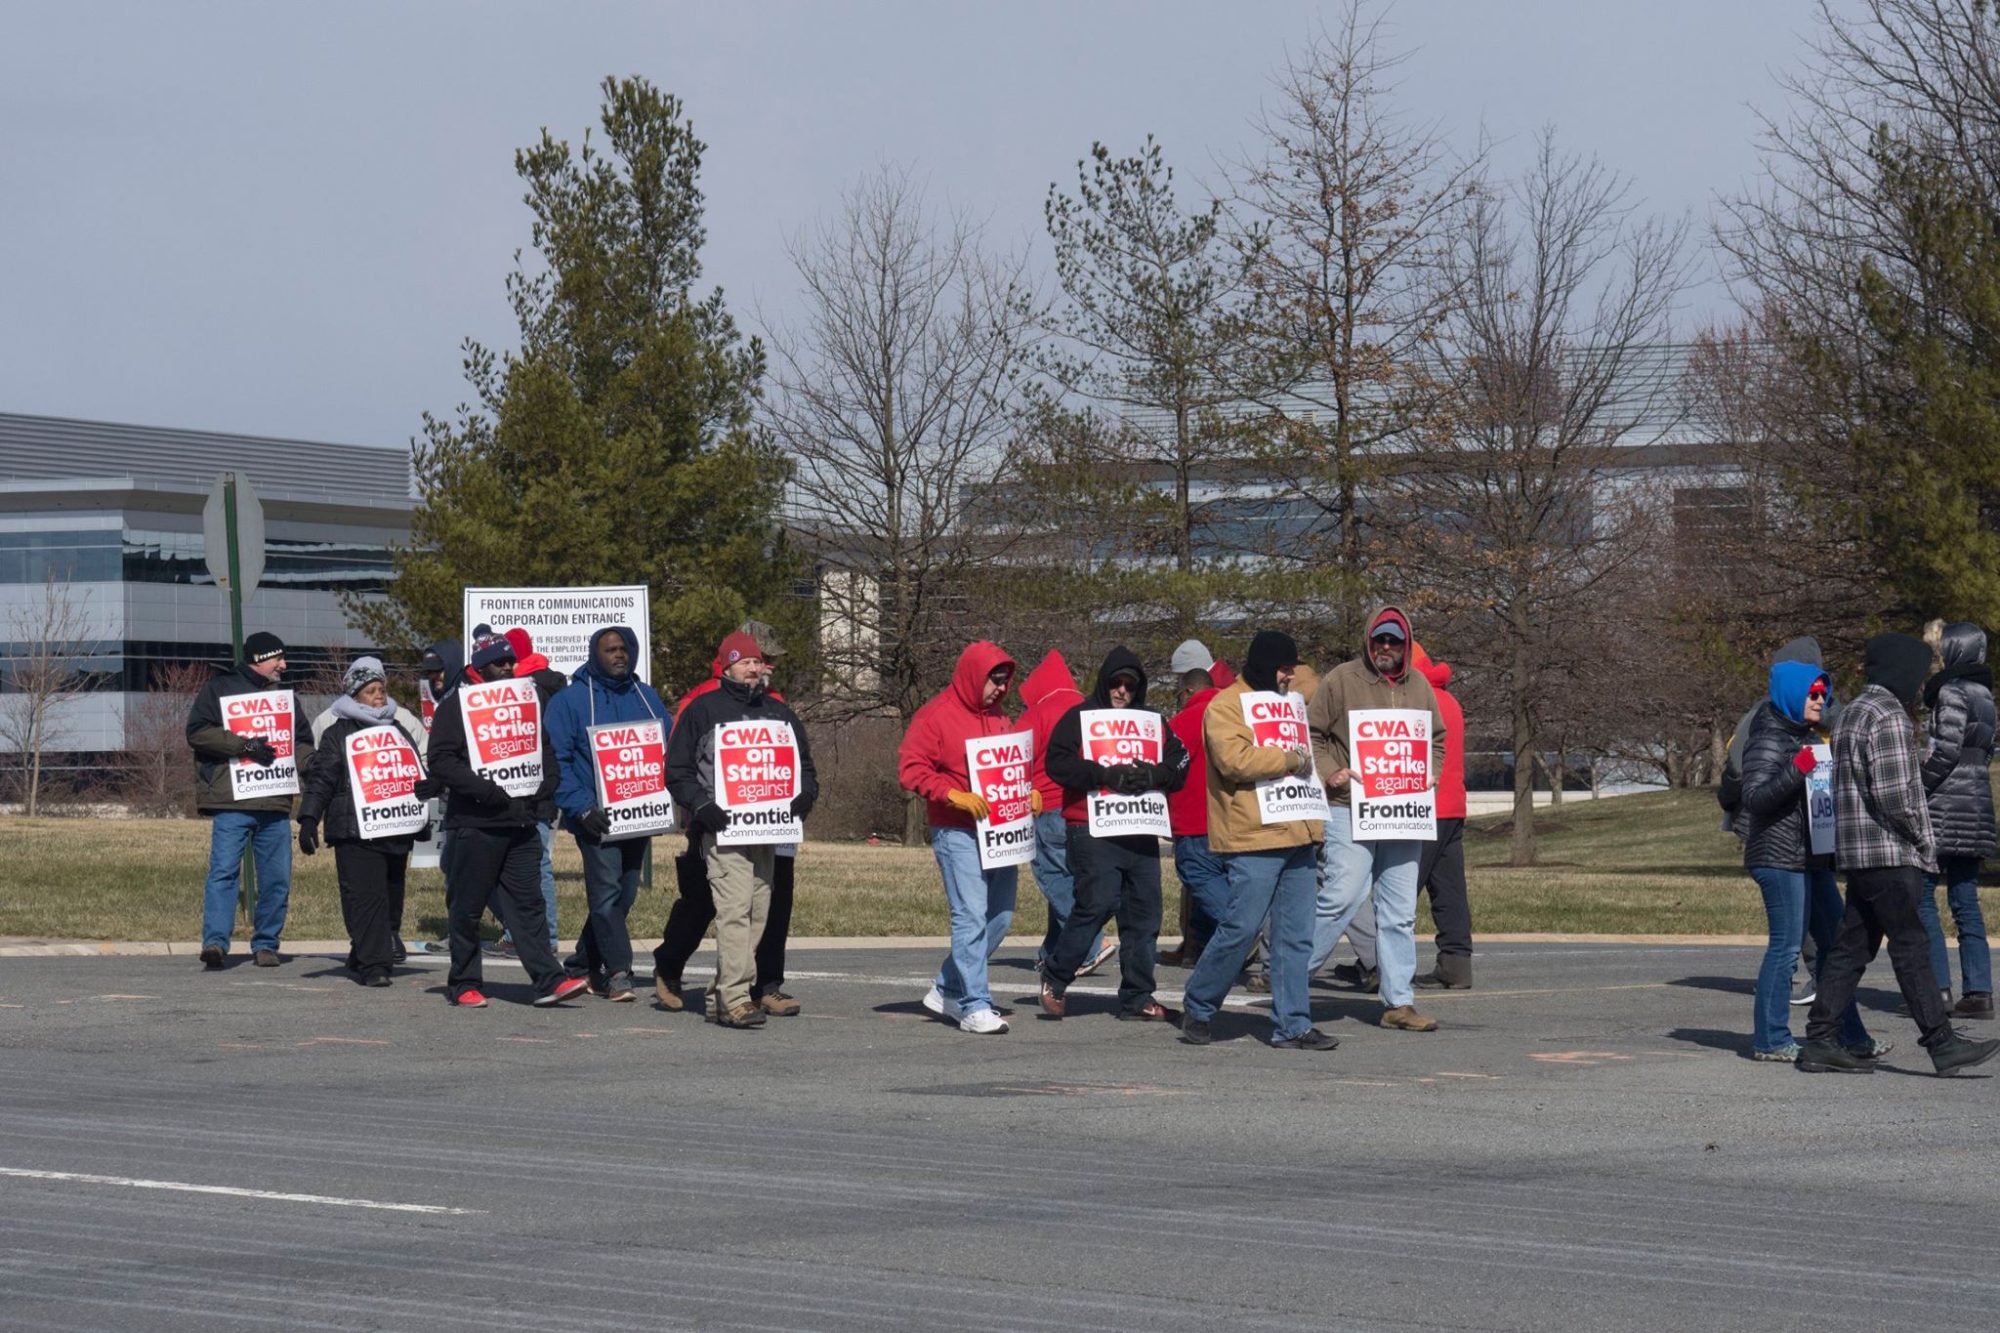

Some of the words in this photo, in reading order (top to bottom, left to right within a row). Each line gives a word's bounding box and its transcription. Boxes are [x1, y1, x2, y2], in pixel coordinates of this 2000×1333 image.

[480, 599, 535, 610] FRONTIER
[538, 597, 634, 610] COMMUNICATIONS
[490, 614, 569, 626] CORPORATION
[571, 612, 626, 624] ENTRANCE
[536, 635, 544, 644] IS
[545, 634, 582, 644] RESERVED
[536, 645, 549, 653] THE
[467, 687, 518, 708] CWA
[227, 698, 273, 716] CWA
[494, 705, 522, 721] on
[1250, 702, 1296, 720] CWA
[252, 714, 277, 728] on
[1089, 720, 1140, 737] CWA
[1279, 722, 1298, 738] on
[1357, 720, 1411, 738] CWA
[477, 720, 536, 741] Strike
[595, 728, 641, 747] CWA
[721, 728, 773, 746] CWA
[352, 732, 397, 752] CWA
[490, 737, 535, 759] against
[1116, 739, 1144, 755] on
[1384, 741, 1413, 756] on
[376, 749, 402, 764] on
[619, 747, 644, 762] on
[746, 748, 776, 763] on
[976, 745, 1023, 767] CWA
[235, 764, 295, 784] Frontier
[361, 761, 419, 782] Strike
[605, 761, 661, 781] Strike
[727, 763, 792, 782] Strike
[1003, 765, 1025, 781] on
[1364, 756, 1426, 775] Strike
[237, 781, 298, 794] Communications
[373, 778, 416, 799] against
[616, 777, 661, 799] against
[738, 782, 790, 803] against
[1264, 783, 1323, 802] Frontier
[1375, 776, 1425, 795] against
[361, 801, 424, 822] Frontier
[604, 801, 671, 822] Frontier
[1094, 798, 1165, 817] Frontier
[1358, 801, 1432, 819] Frontier
[722, 826, 800, 838] Communications
[1095, 817, 1168, 829] Communications
[1359, 820, 1434, 831] Communications
